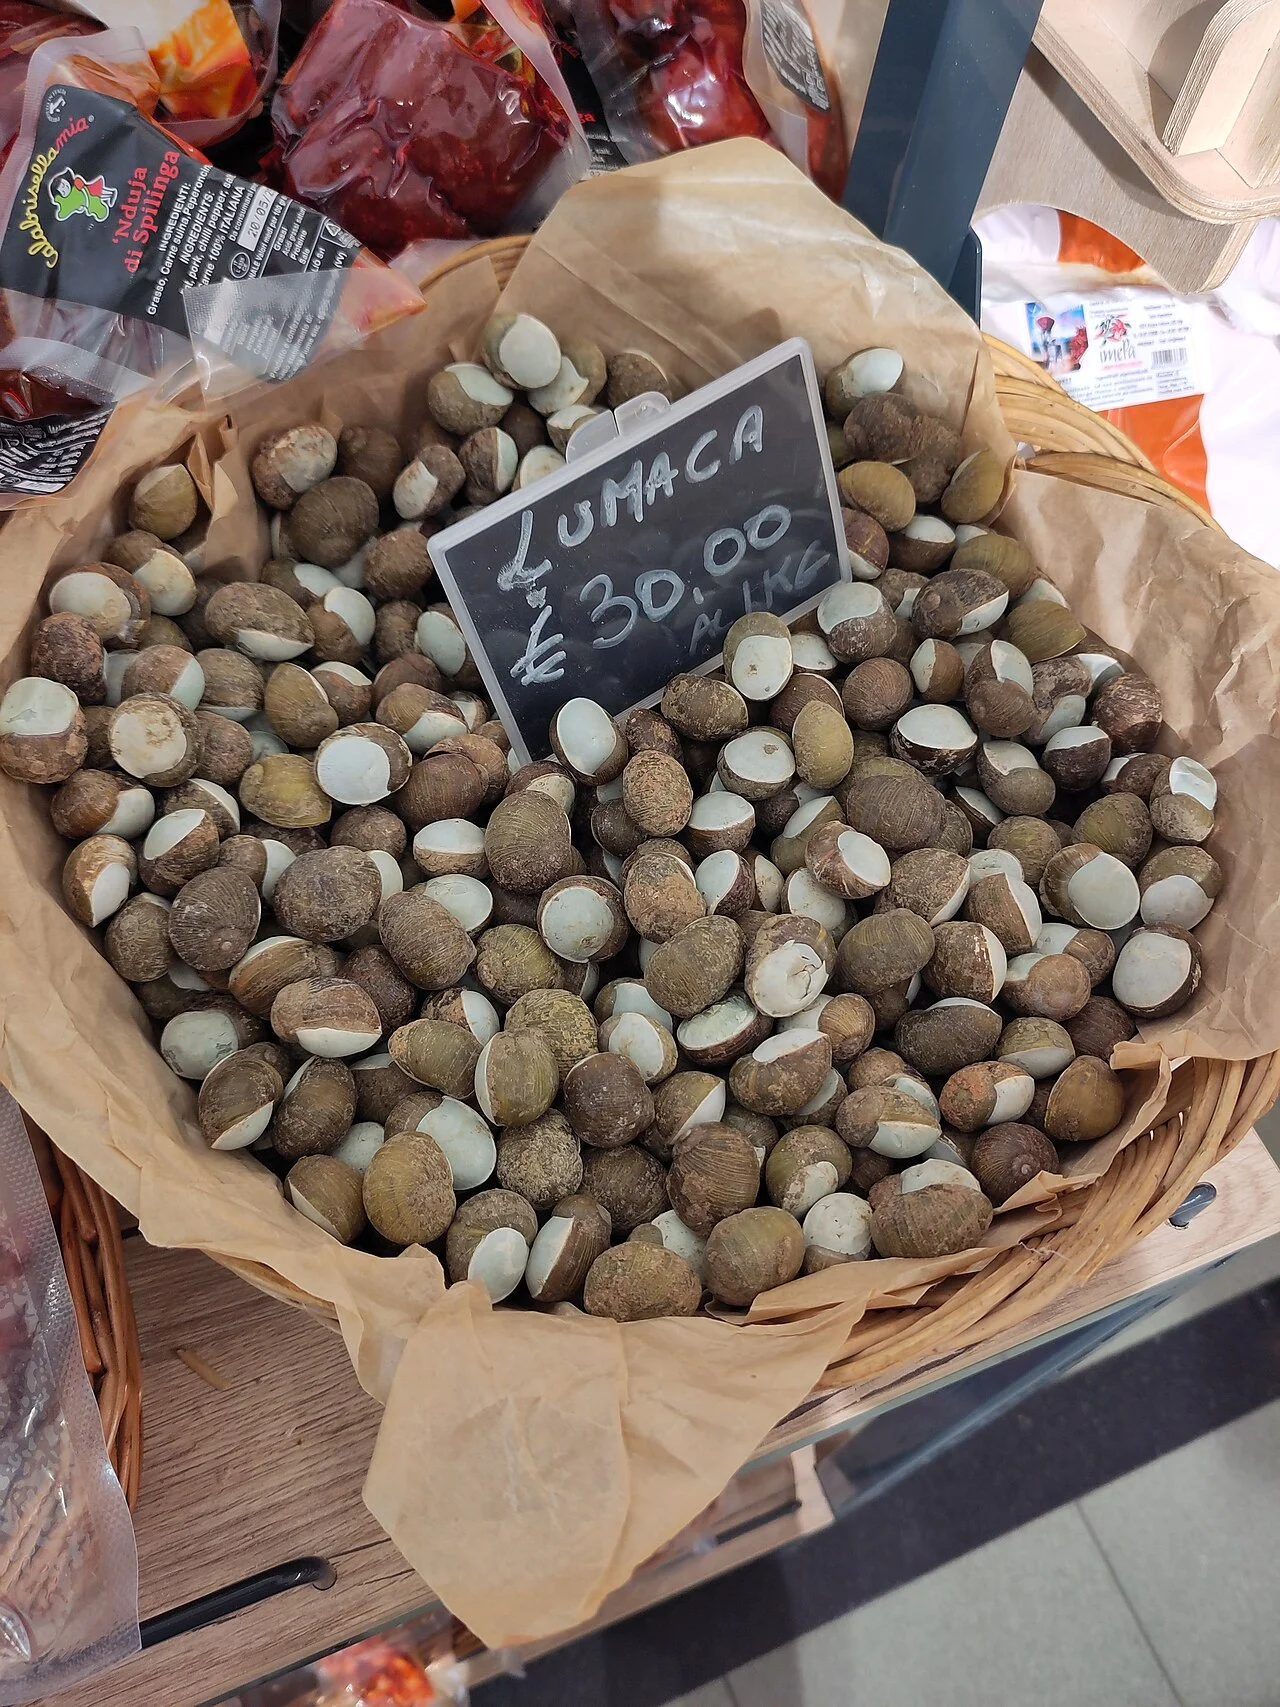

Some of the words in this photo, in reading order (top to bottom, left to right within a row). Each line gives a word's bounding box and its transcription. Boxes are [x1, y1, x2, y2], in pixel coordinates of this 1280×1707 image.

[132, 151, 180, 244] Spilinga
[158, 183, 191, 251] INGREDIENTI:
[180, 191, 215, 264] INGREDIENTS:
[210, 235, 225, 261] 100%
[219, 186, 244, 234] ITALIANA
[229, 230, 238, 241] Da
[235, 189, 254, 230] consumarsi
[124, 249, 144, 273] di
[189, 254, 204, 279] pork,
[199, 227, 213, 252] chilli
[209, 188, 229, 226] pepper,
[248, 260, 261, 280] NALE
[256, 243, 268, 261] Valori
[263, 226, 274, 243] medi
[270, 214, 280, 227] per
[273, 226, 288, 251] Grassi
[283, 242, 293, 256] Acidi
[290, 223, 301, 241] grassi
[291, 230, 308, 260] Proteine
[299, 248, 310, 264] Sale
[147, 277, 168, 315] Grasso,
[160, 247, 178, 275] Carne
[498, 405, 763, 591] LUMACA
